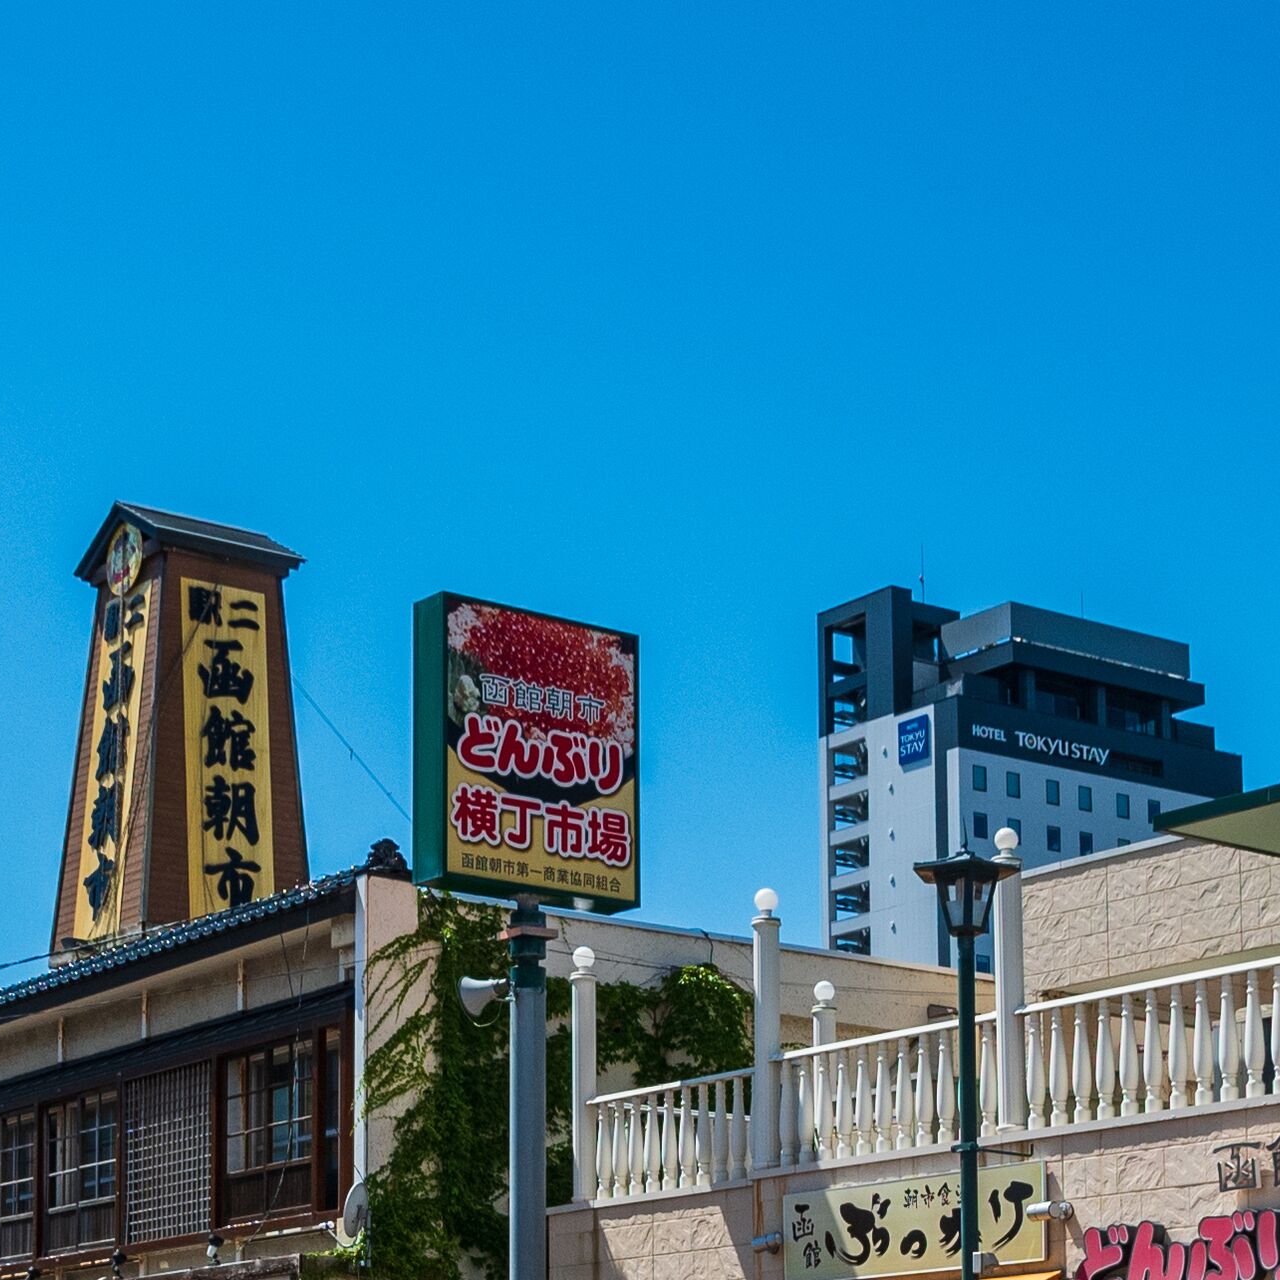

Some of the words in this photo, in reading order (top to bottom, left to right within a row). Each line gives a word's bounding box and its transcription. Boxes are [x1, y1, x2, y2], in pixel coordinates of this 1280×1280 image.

[479, 672, 605, 725] 函館朝市
[458, 713, 623, 796] どんぶり
[900, 729, 925, 743] TOKYU
[900, 740, 925, 757] STAY
[972, 723, 1007, 742] HOTEL
[198, 639, 261, 905] 函館朝市
[452, 783, 631, 867] 横丁市場
[903, 1182, 962, 1210] 朝市食
[791, 1203, 822, 1270] 函館
